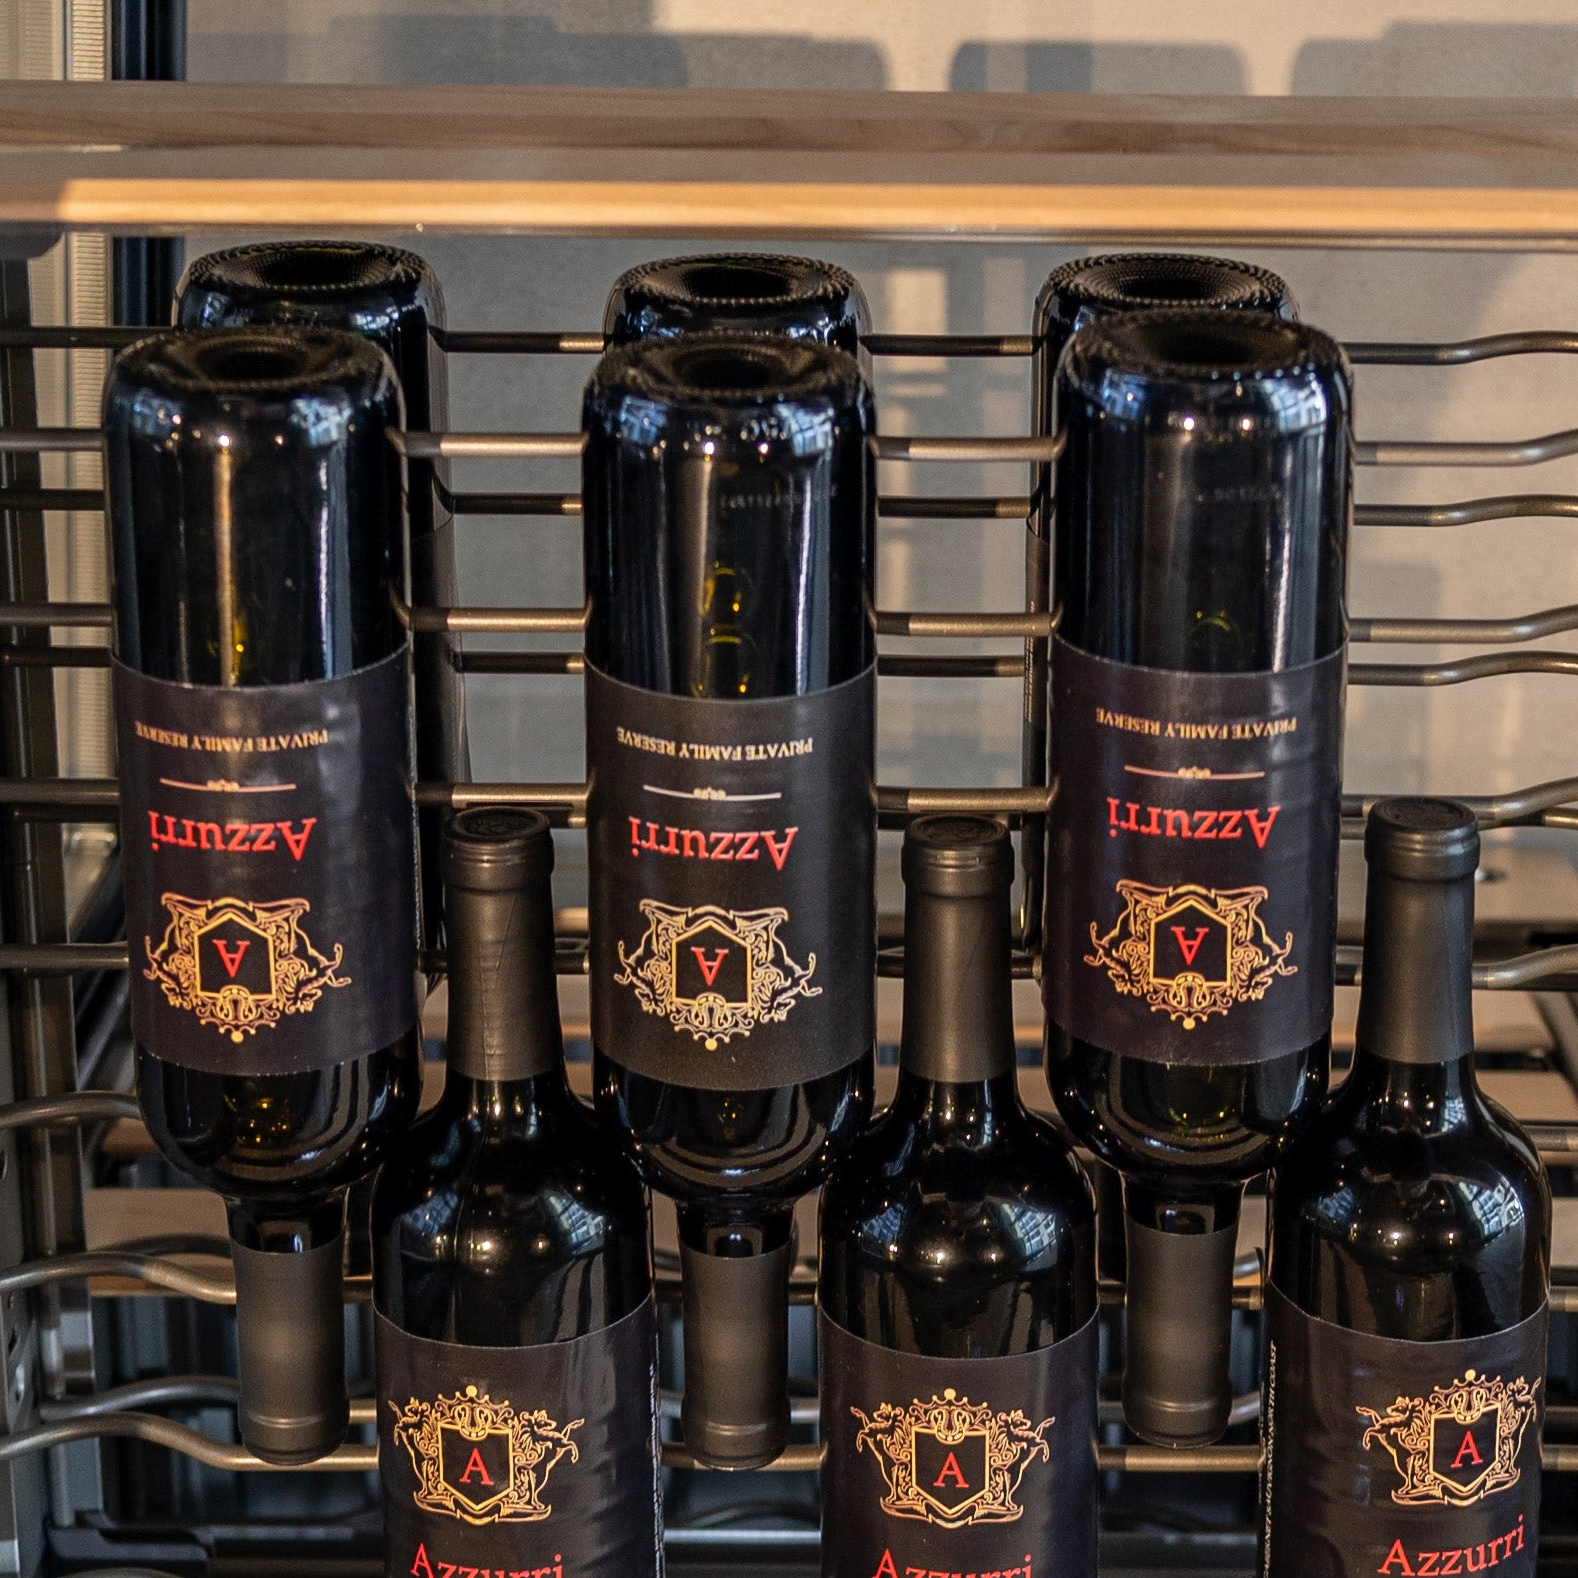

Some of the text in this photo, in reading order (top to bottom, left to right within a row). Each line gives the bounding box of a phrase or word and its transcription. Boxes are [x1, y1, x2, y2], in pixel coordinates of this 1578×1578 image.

[134, 720, 329, 753] PRIVATE FAMILY RESERVE
[1096, 707, 1298, 740] PRIVATE FAMILY RESERVE
[616, 726, 814, 761] PRIVATE FAMILY RESERVE
[148, 811, 317, 861] Azzurri
[1107, 797, 1282, 849] Azzurri
[629, 816, 799, 871] Azzurri
[212, 938, 250, 978] A
[1171, 926, 1209, 965] A
[690, 946, 729, 986] A
[459, 1447, 494, 1486] A
[1450, 1430, 1483, 1469] A
[933, 1451, 969, 1488] A
[1377, 1514, 1524, 1577] Azzurri
